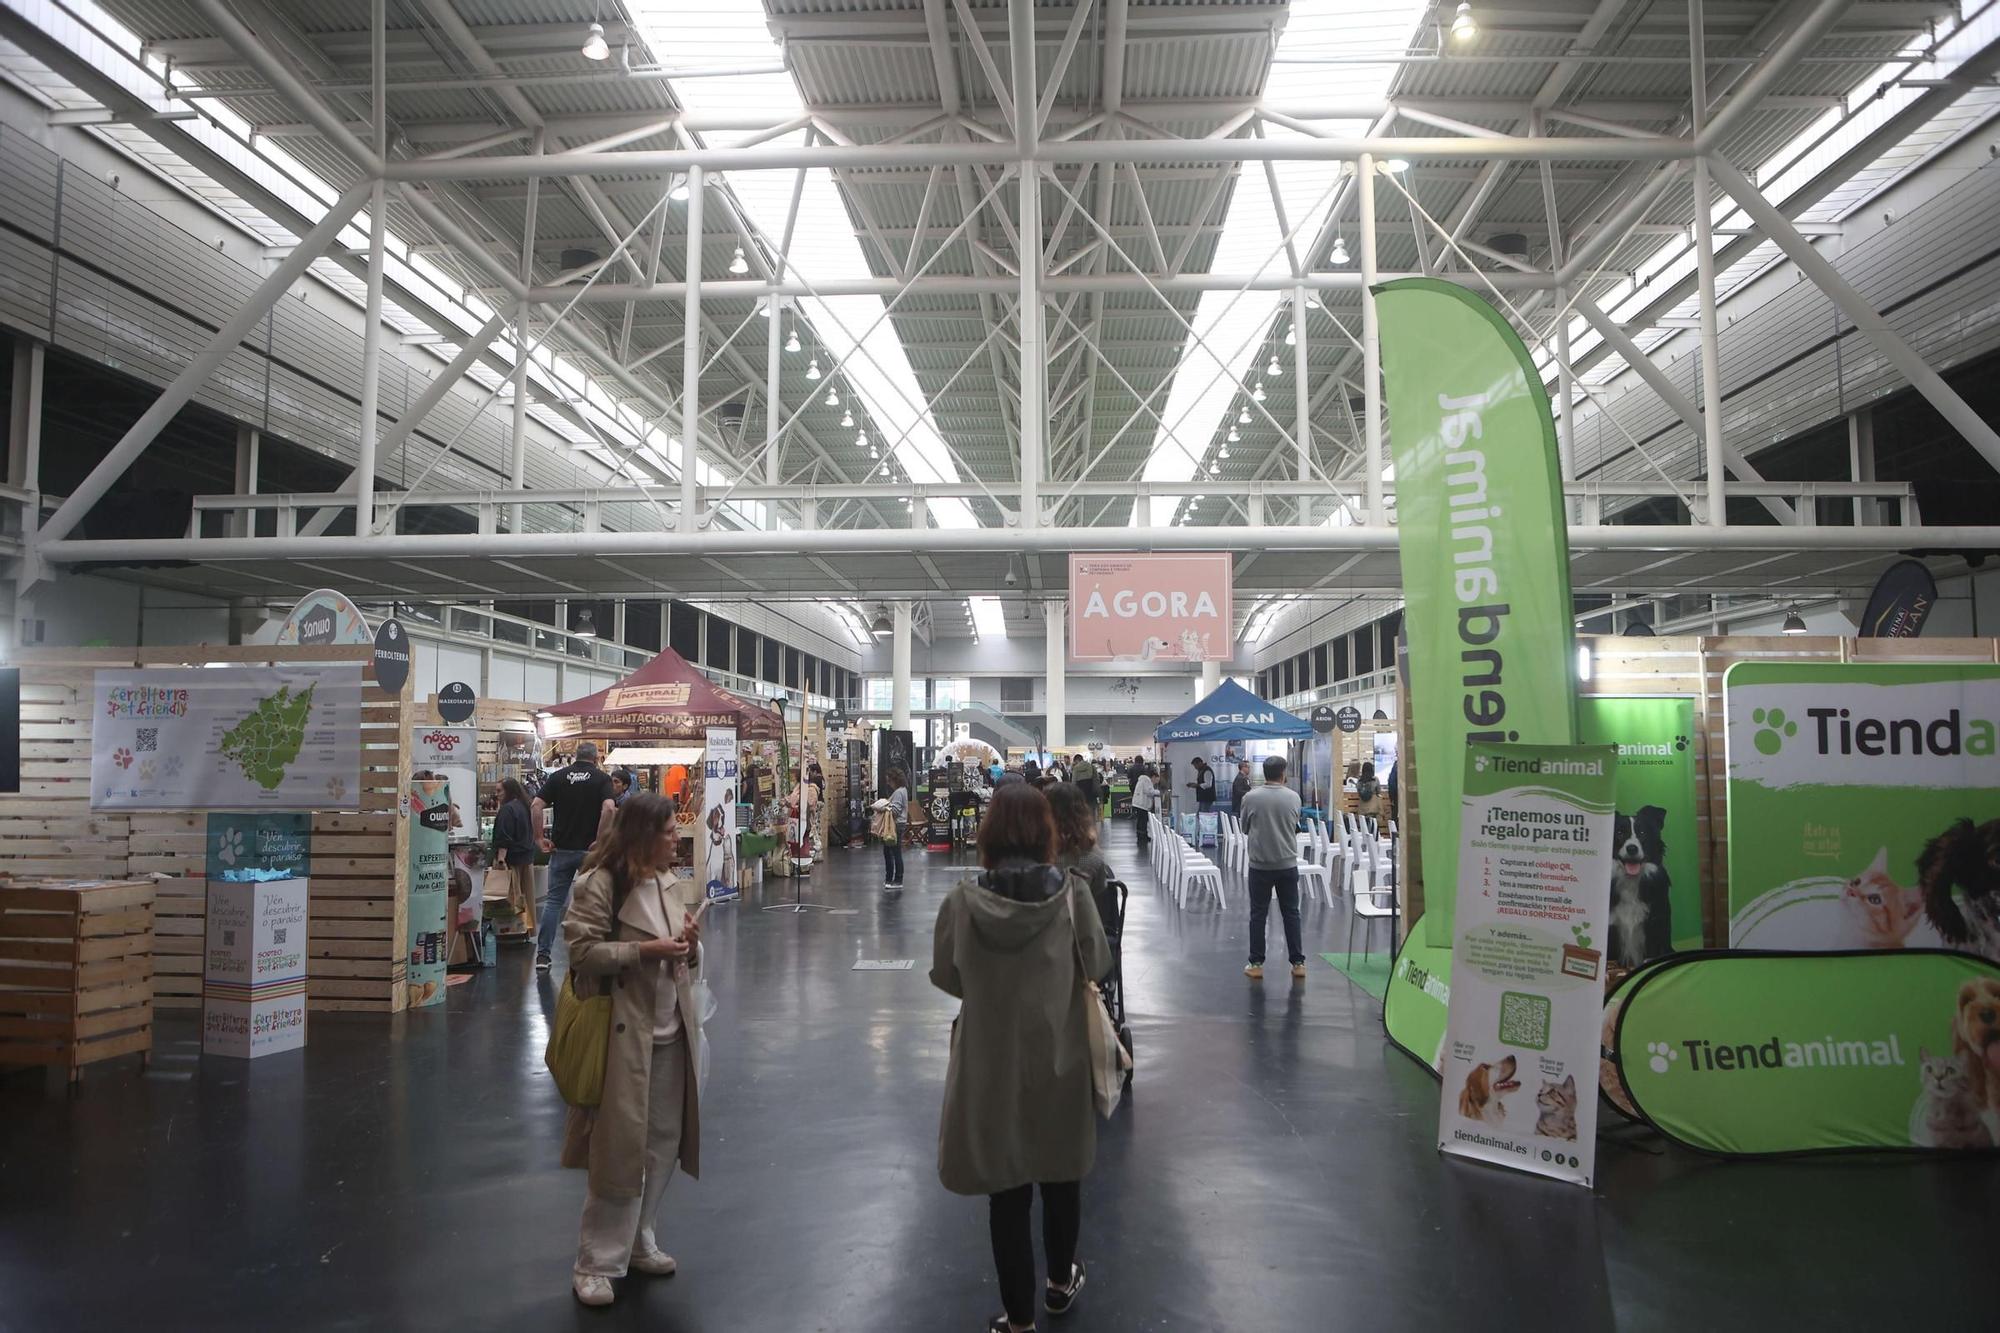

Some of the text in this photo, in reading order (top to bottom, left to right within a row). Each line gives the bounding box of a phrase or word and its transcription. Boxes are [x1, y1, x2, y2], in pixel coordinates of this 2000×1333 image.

[1083, 583, 1218, 618] ÁGORA
[1888, 609, 1906, 639] URINA
[620, 689, 679, 700] NATURAL
[677, 714, 735, 725] NATURAL
[1194, 712, 1275, 725] OCEAN
[639, 725, 666, 735] PARA
[1806, 707, 2000, 757] Tienda
[1617, 742, 1673, 755] animal
[1491, 756, 1604, 776] Tiendanimal
[1487, 806, 1585, 825] ¡Tenemos un
[1481, 823, 1590, 842] regalo para ti!
[1572, 848, 1599, 857] pasos:
[1500, 858, 1527, 868] Captura
[1535, 860, 1559, 870] código
[1483, 867, 1491, 875] 2.
[1499, 869, 1532, 879] Completa
[1517, 882, 1544, 891] nuestro
[1543, 895, 1563, 903] email
[1498, 899, 1543, 910] confirmación
[1549, 903, 1575, 913] tendrás
[1405, 959, 1450, 1008] Tiendanima
[1682, 1034, 1905, 1071] Tiendanimal
[1454, 1128, 1528, 1156] tiendanimal.es
